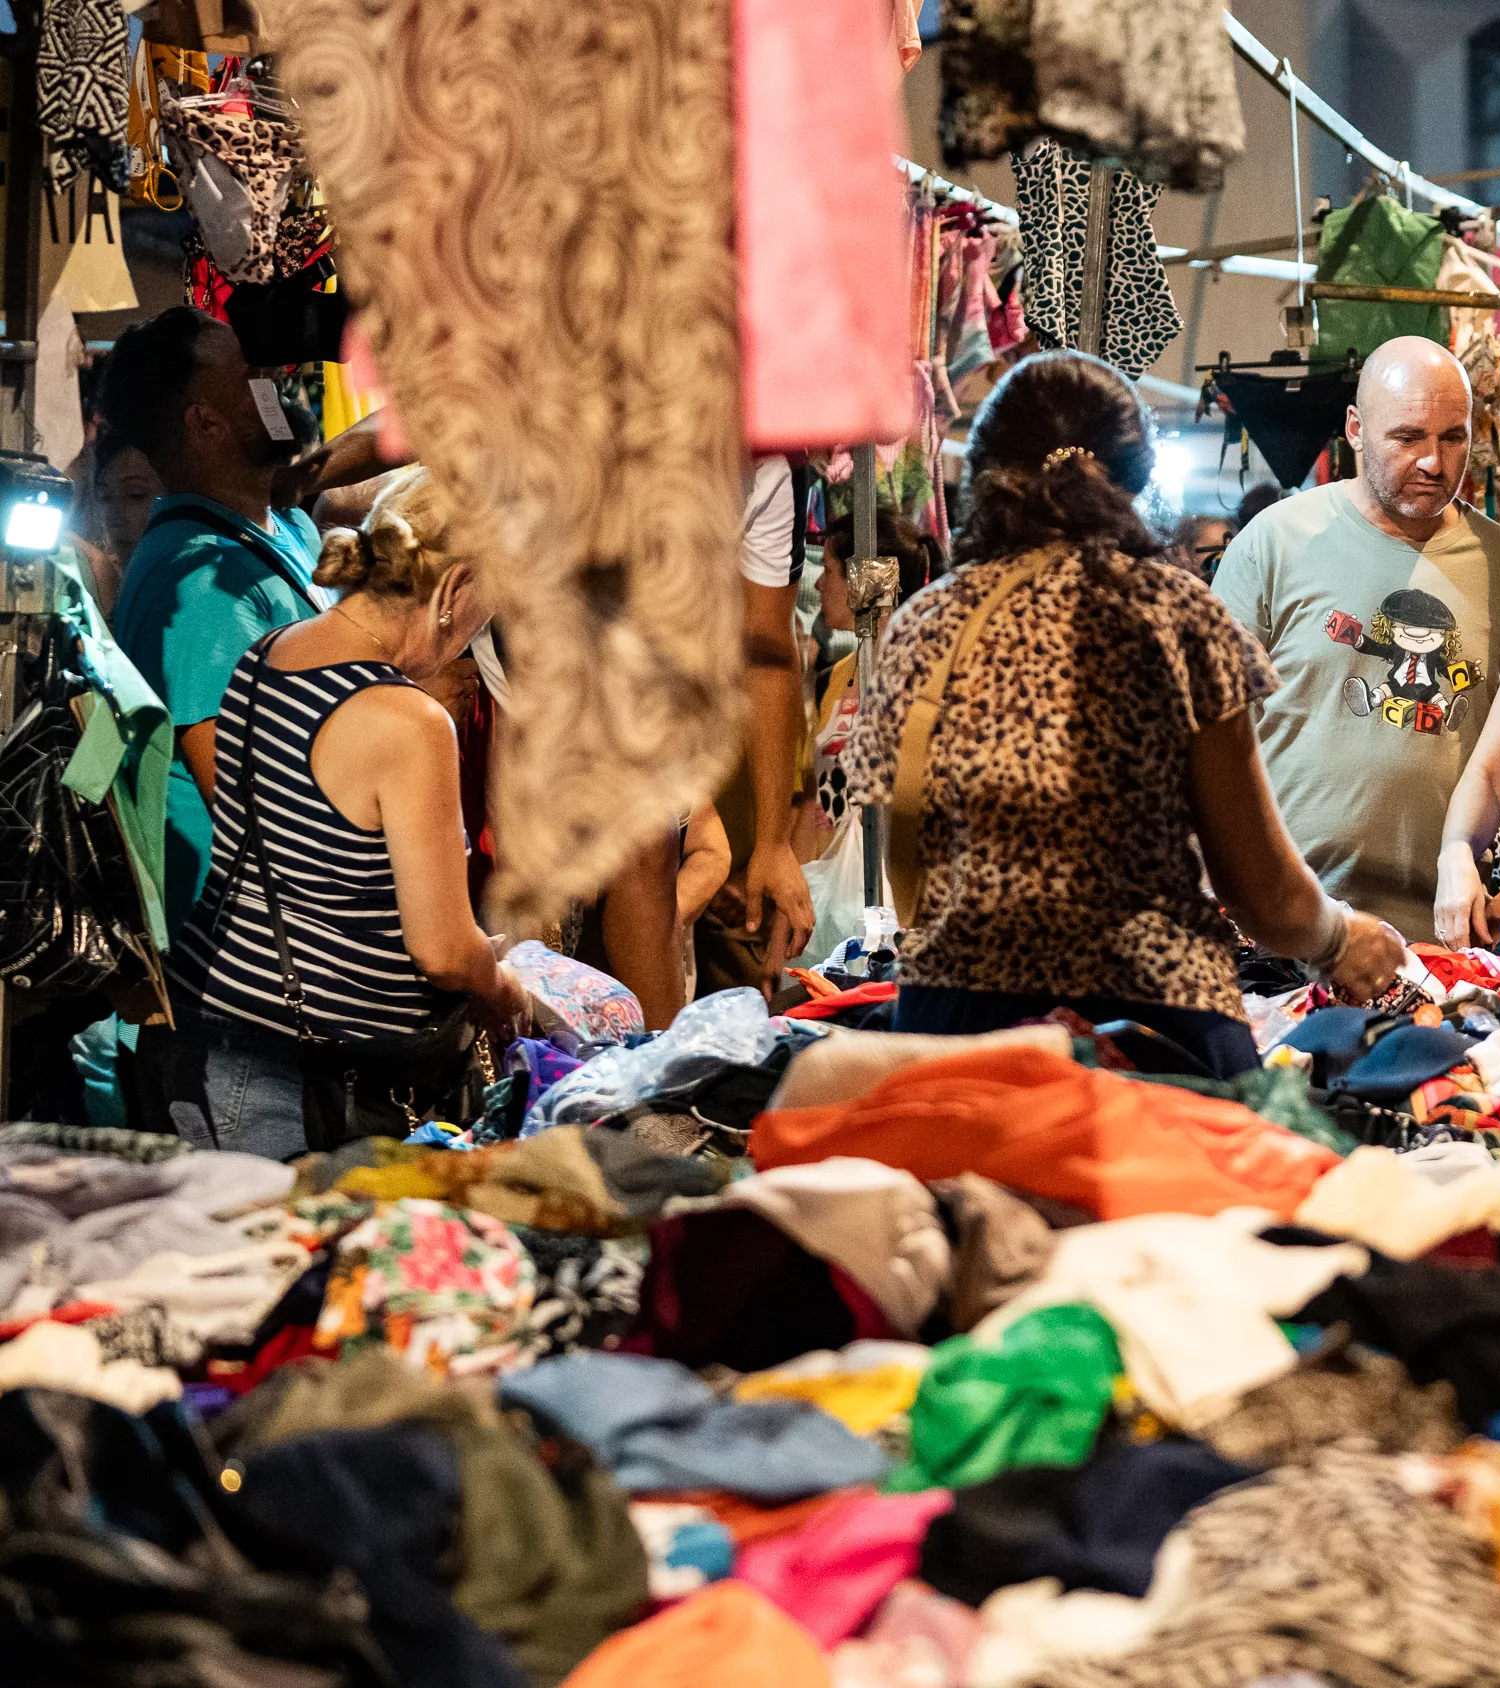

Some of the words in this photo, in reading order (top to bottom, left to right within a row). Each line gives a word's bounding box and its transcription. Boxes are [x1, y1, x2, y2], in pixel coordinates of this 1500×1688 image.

[1327, 617, 1337, 633] A
[1452, 668, 1468, 686] C
[1385, 707, 1398, 723] C
[1422, 713, 1437, 731] D
